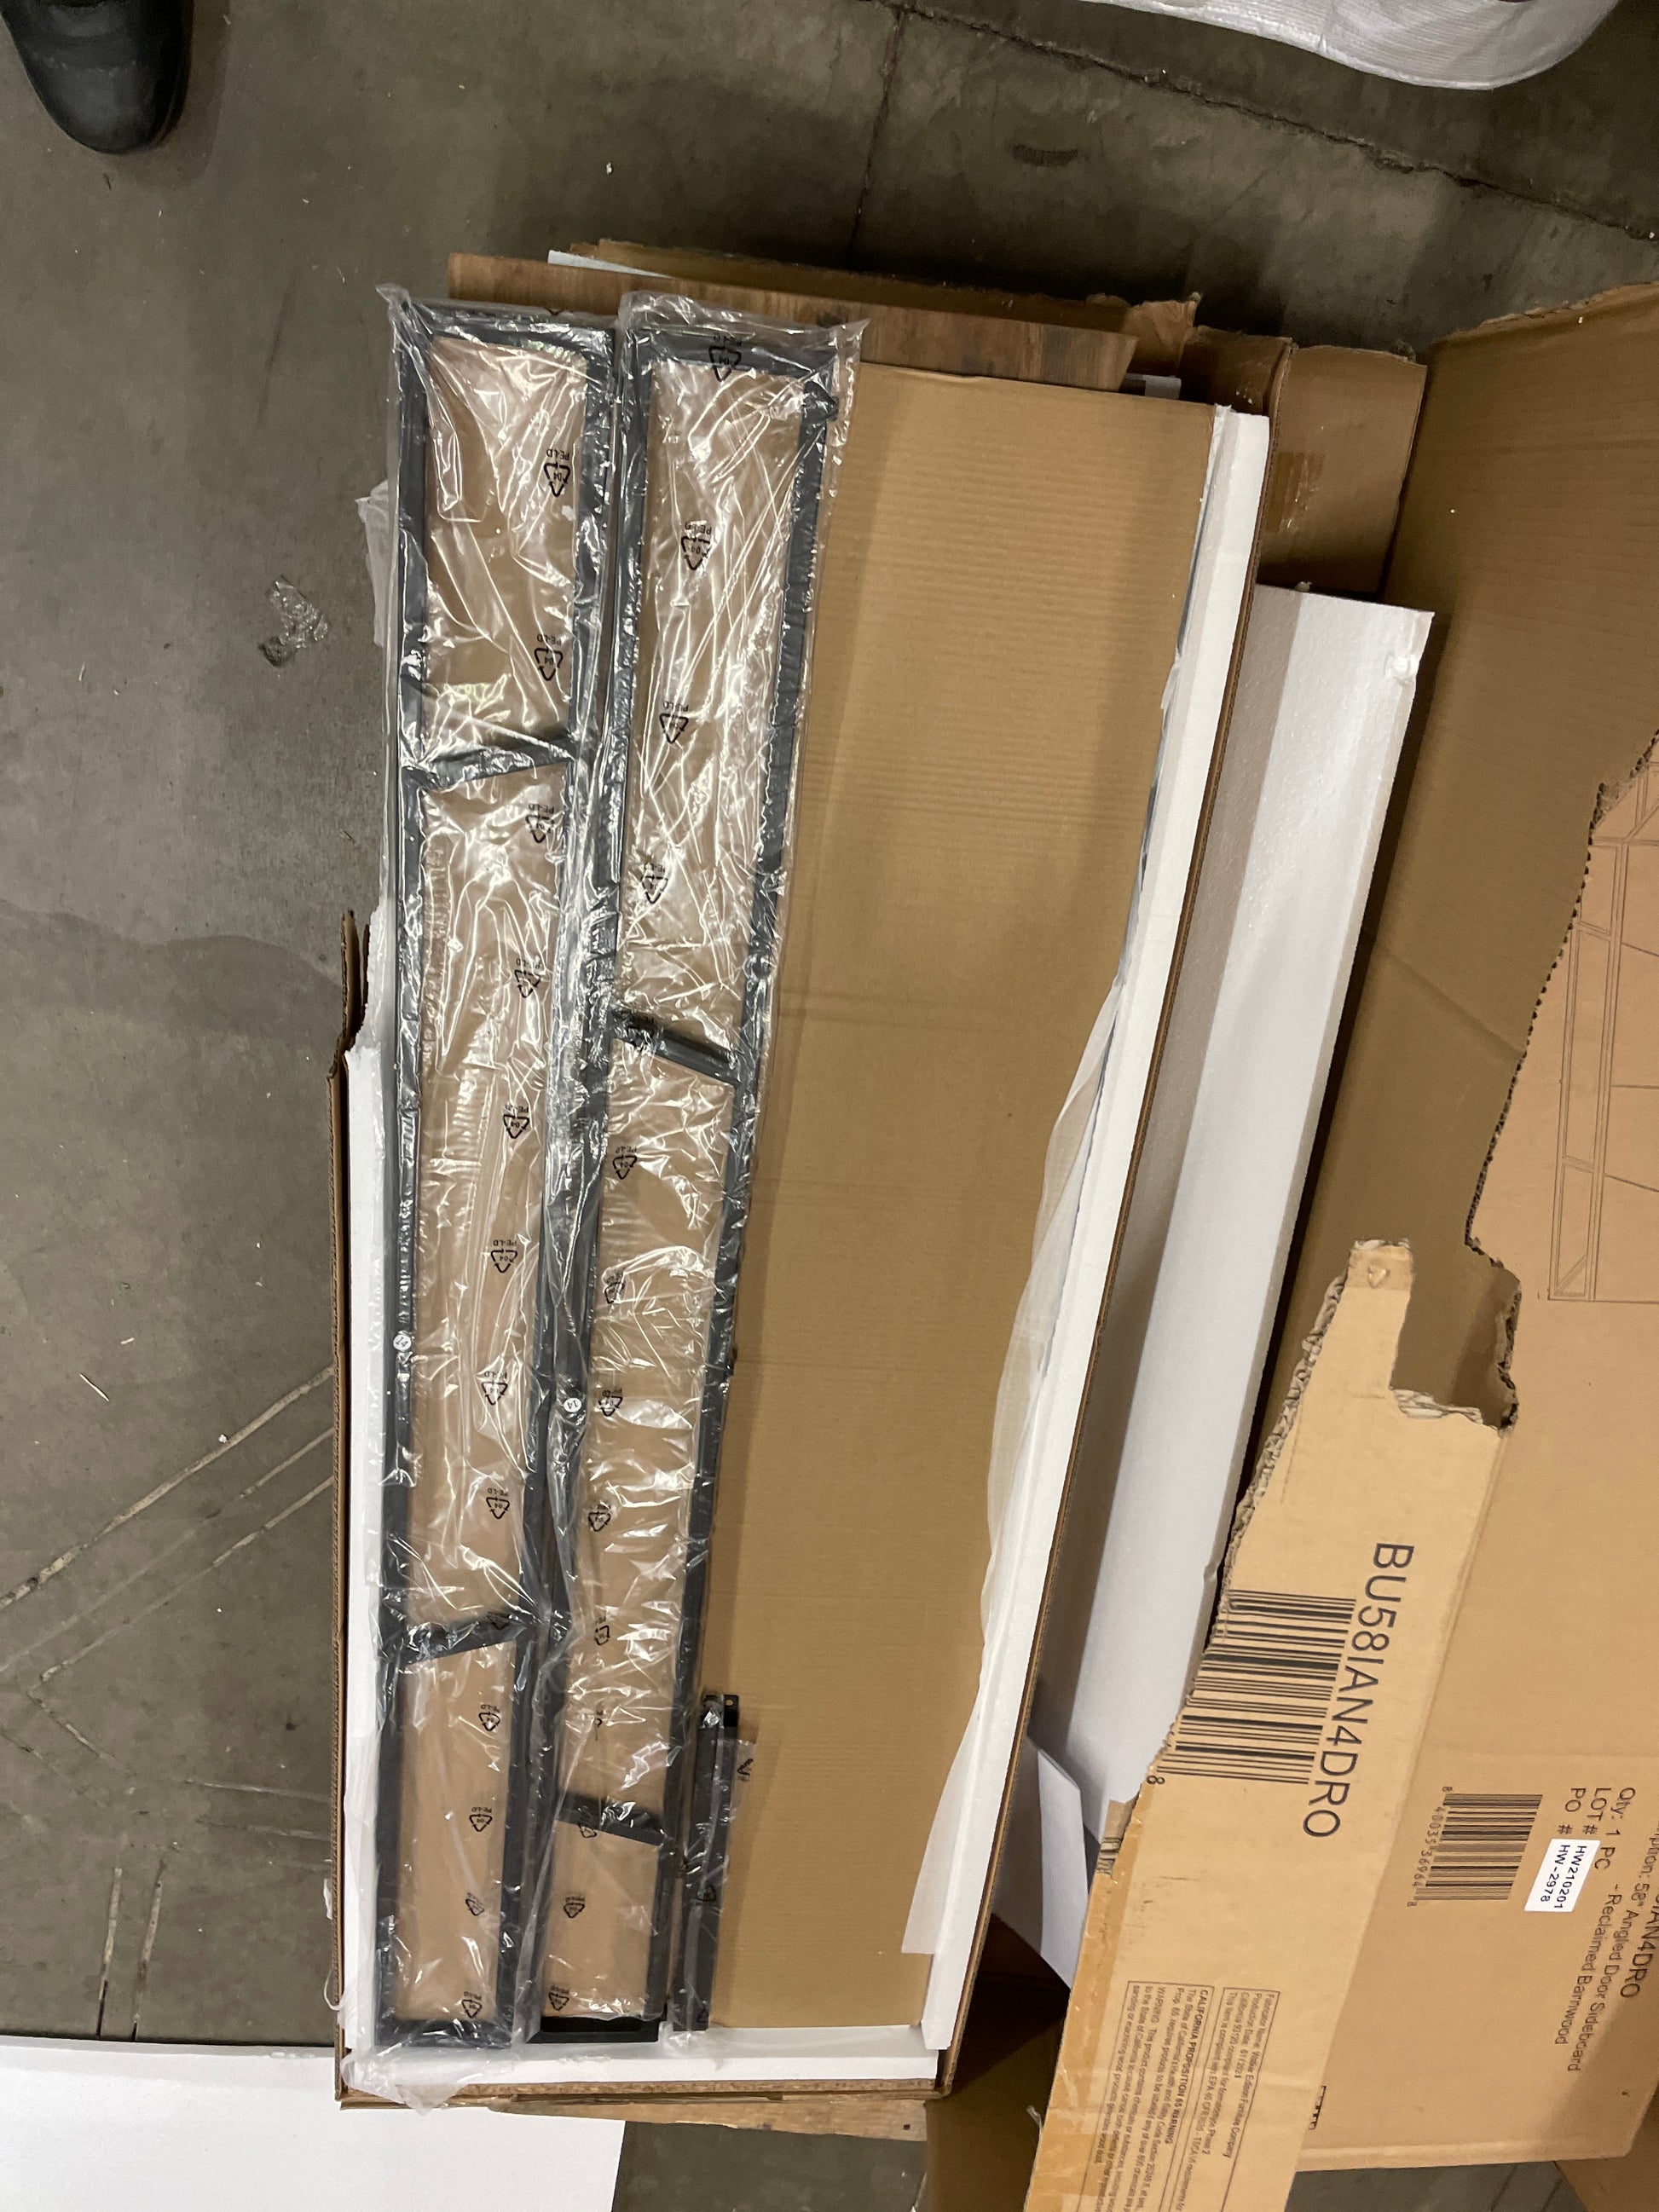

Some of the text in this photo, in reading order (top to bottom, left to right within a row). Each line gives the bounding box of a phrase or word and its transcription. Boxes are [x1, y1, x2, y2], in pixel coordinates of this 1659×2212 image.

[546, 448, 569, 460] PE-LD
[537, 634, 562, 646] PE-LD
[567, 1401, 579, 1409] 14
[487, 1487, 509, 1497] PE-LD
[1303, 1543, 1415, 1838] BU58IAN4DRO
[1146, 1775, 1165, 1785] 8
[1610, 1788, 1636, 1820] Qty:
[1425, 1806, 1445, 1845] 40035
[1540, 1788, 1586, 1903] PO # HW-2978
[1553, 1788, 1611, 1909] LOT # HW210201
[1412, 1850, 1432, 1886] 36964
[1594, 1846, 1616, 1869] PC
[1632, 1883, 1650, 1906] 58"
[1609, 1910, 1639, 1961] Angled
[1595, 1965, 1621, 1998] Door
[1142, 1995, 1153, 2004] the
[1186, 1989, 1196, 2001] The
[1226, 1992, 1237, 2005] This
[1137, 2007, 1151, 2024] State
[1182, 2004, 1193, 2020] State
[1188, 1990, 1210, 2039] CALIFORNIA
[1223, 2007, 1233, 2020] item
[1234, 1992, 1249, 2022] California
[1246, 1993, 1262, 2026] Production
[1554, 1975, 1593, 2045] Barnwood
[1147, 2029, 1157, 2042] This
[1211, 2030, 1228, 2059] compliant
[1229, 2024, 1241, 2044] 93120
[1567, 2002, 1605, 2071] Sideboard
[1128, 2033, 1145, 2063] California
[1139, 2043, 1153, 2066] product
[1115, 2055, 1125, 2071] wood
[1155, 2047, 1170, 2072] products
[1175, 2042, 1197, 2095] PROPOSITION
[1221, 2045, 1235, 2075] compliant
[1107, 2073, 1122, 2101] products
[1165, 2066, 1179, 2088] Health
[1206, 2076, 1217, 2090] EPA
[1219, 2077, 1228, 2086] for
[1163, 2089, 1173, 2100] and
[1157, 2102, 1171, 2120] Safety
[1199, 2101, 1211, 2115] CFR
[1142, 2119, 1153, 2130] any
[1153, 2122, 1165, 2137] Code
[1165, 2109, 1180, 2143] WARNING
[1097, 2133, 1107, 2148] wood
[1108, 2130, 1122, 2151] defects
[1137, 2140, 1147, 2152] over
[1147, 2140, 1161, 2162] Section
[1223, 2127, 1240, 2157] Company
[1103, 2160, 1115, 2175] other
